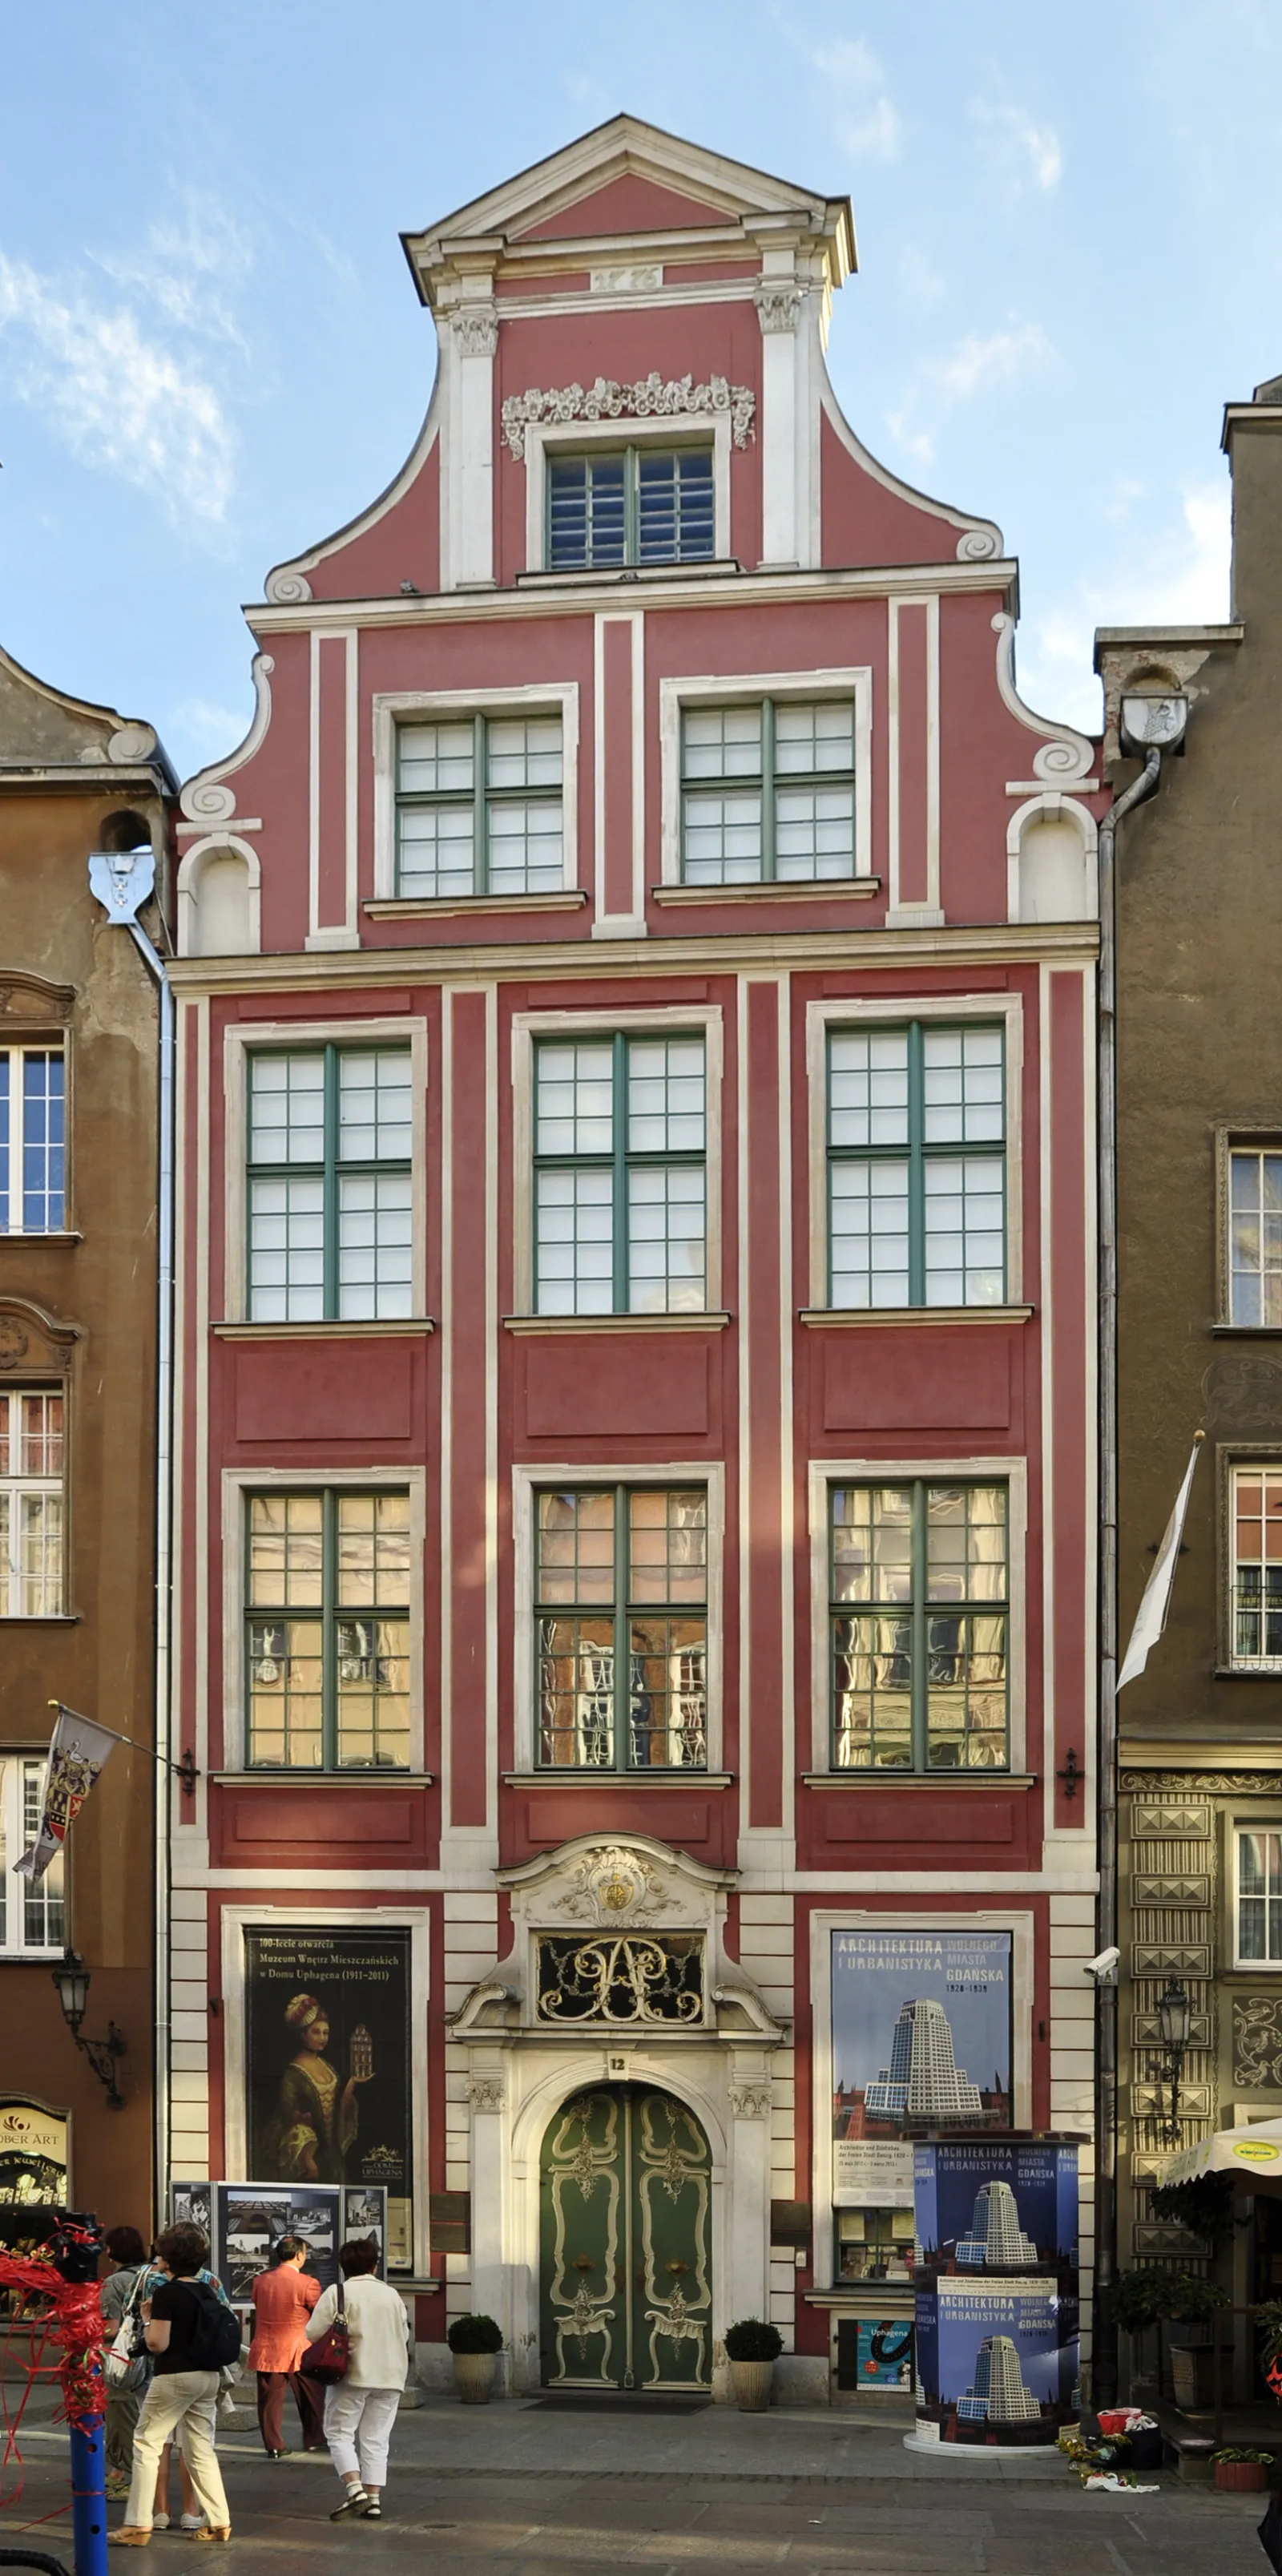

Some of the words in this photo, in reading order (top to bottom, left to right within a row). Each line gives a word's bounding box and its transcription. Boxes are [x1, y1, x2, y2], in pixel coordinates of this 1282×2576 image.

[298, 1940, 334, 1948] otwarcia
[838, 1938, 943, 1954] ARCHITEKTURA
[946, 1940, 997, 1951] WOLNEGO
[260, 1953, 296, 1964] Muzeum
[297, 1954, 329, 1966] Wnętrz
[330, 1955, 399, 1965] Mieszczańskich
[838, 1957, 842, 1969] I
[848, 1957, 942, 1971] URBANISTYKA
[947, 1954, 986, 1965] MIASTA
[268, 1968, 294, 1979] Domu
[296, 1969, 340, 1981] Uphagena
[946, 1967, 1004, 1982] GDAŃSKA
[611, 2058, 625, 2070] 12
[938, 2147, 1013, 2158] ARCHITEKTURA
[944, 2161, 1013, 2171] URBANISTYKA
[1018, 2168, 1054, 2179] GDAŃSKA
[940, 2296, 1014, 2309] ARCHITEKTURA
[1019, 2298, 1049, 2306] WOLNEG
[945, 2311, 1014, 2322] URBANISTYKA
[871, 2328, 908, 2338] Uphagena
